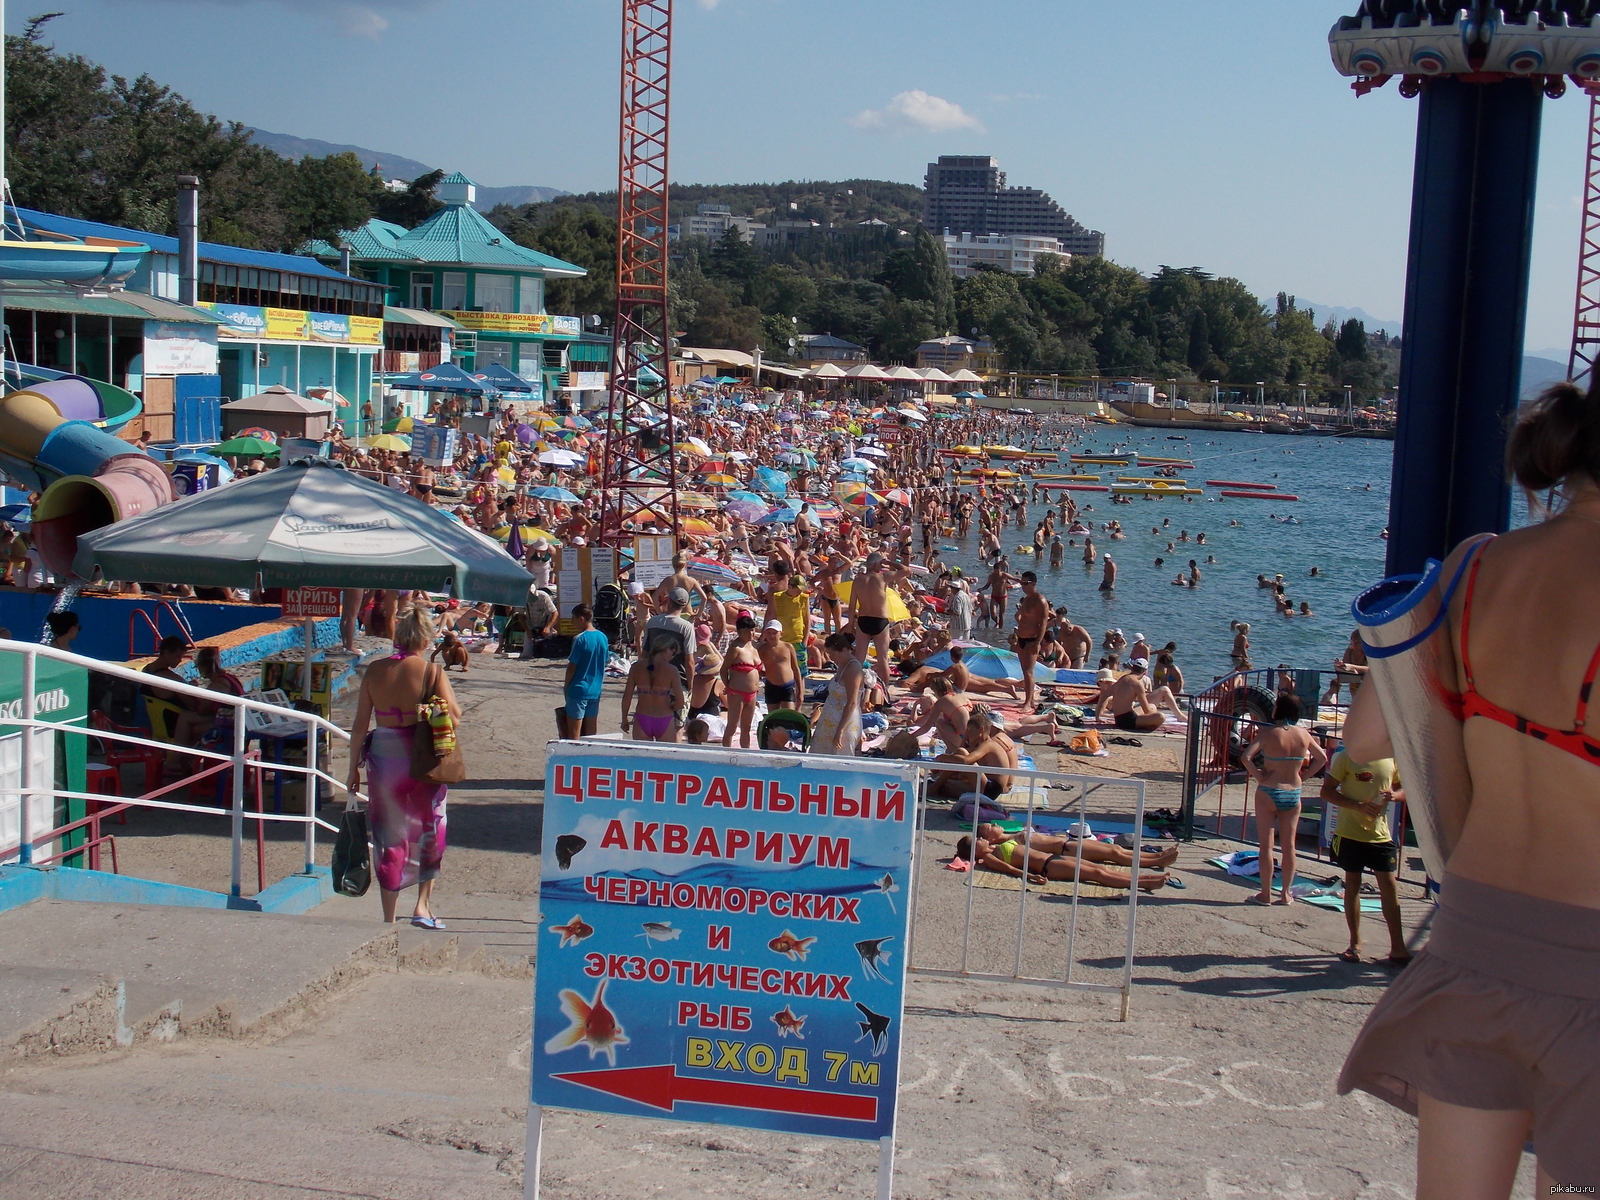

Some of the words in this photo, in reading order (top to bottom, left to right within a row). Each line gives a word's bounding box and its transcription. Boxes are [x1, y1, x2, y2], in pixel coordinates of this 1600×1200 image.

[456, 311, 500, 320] ВЫСТАВКА
[502, 313, 547, 323] ДИНОЗАВРОВ
[281, 513, 396, 536] Staropramen
[285, 604, 337, 615] ЗАПРЕЩЕНО
[286, 590, 337, 604] КУРИТЬ
[553, 764, 906, 823] ЦЕНТРАЛЬНЫЙ
[599, 818, 852, 870] АКВАРИУМ
[583, 875, 861, 925] ЧЕРНОМОРСКИХ
[707, 924, 732, 952] И
[583, 952, 853, 1002] ЭКЗОТИЧЕСКИХ
[677, 1000, 752, 1032] РЫБ
[686, 1036, 809, 1086] ВХОД
